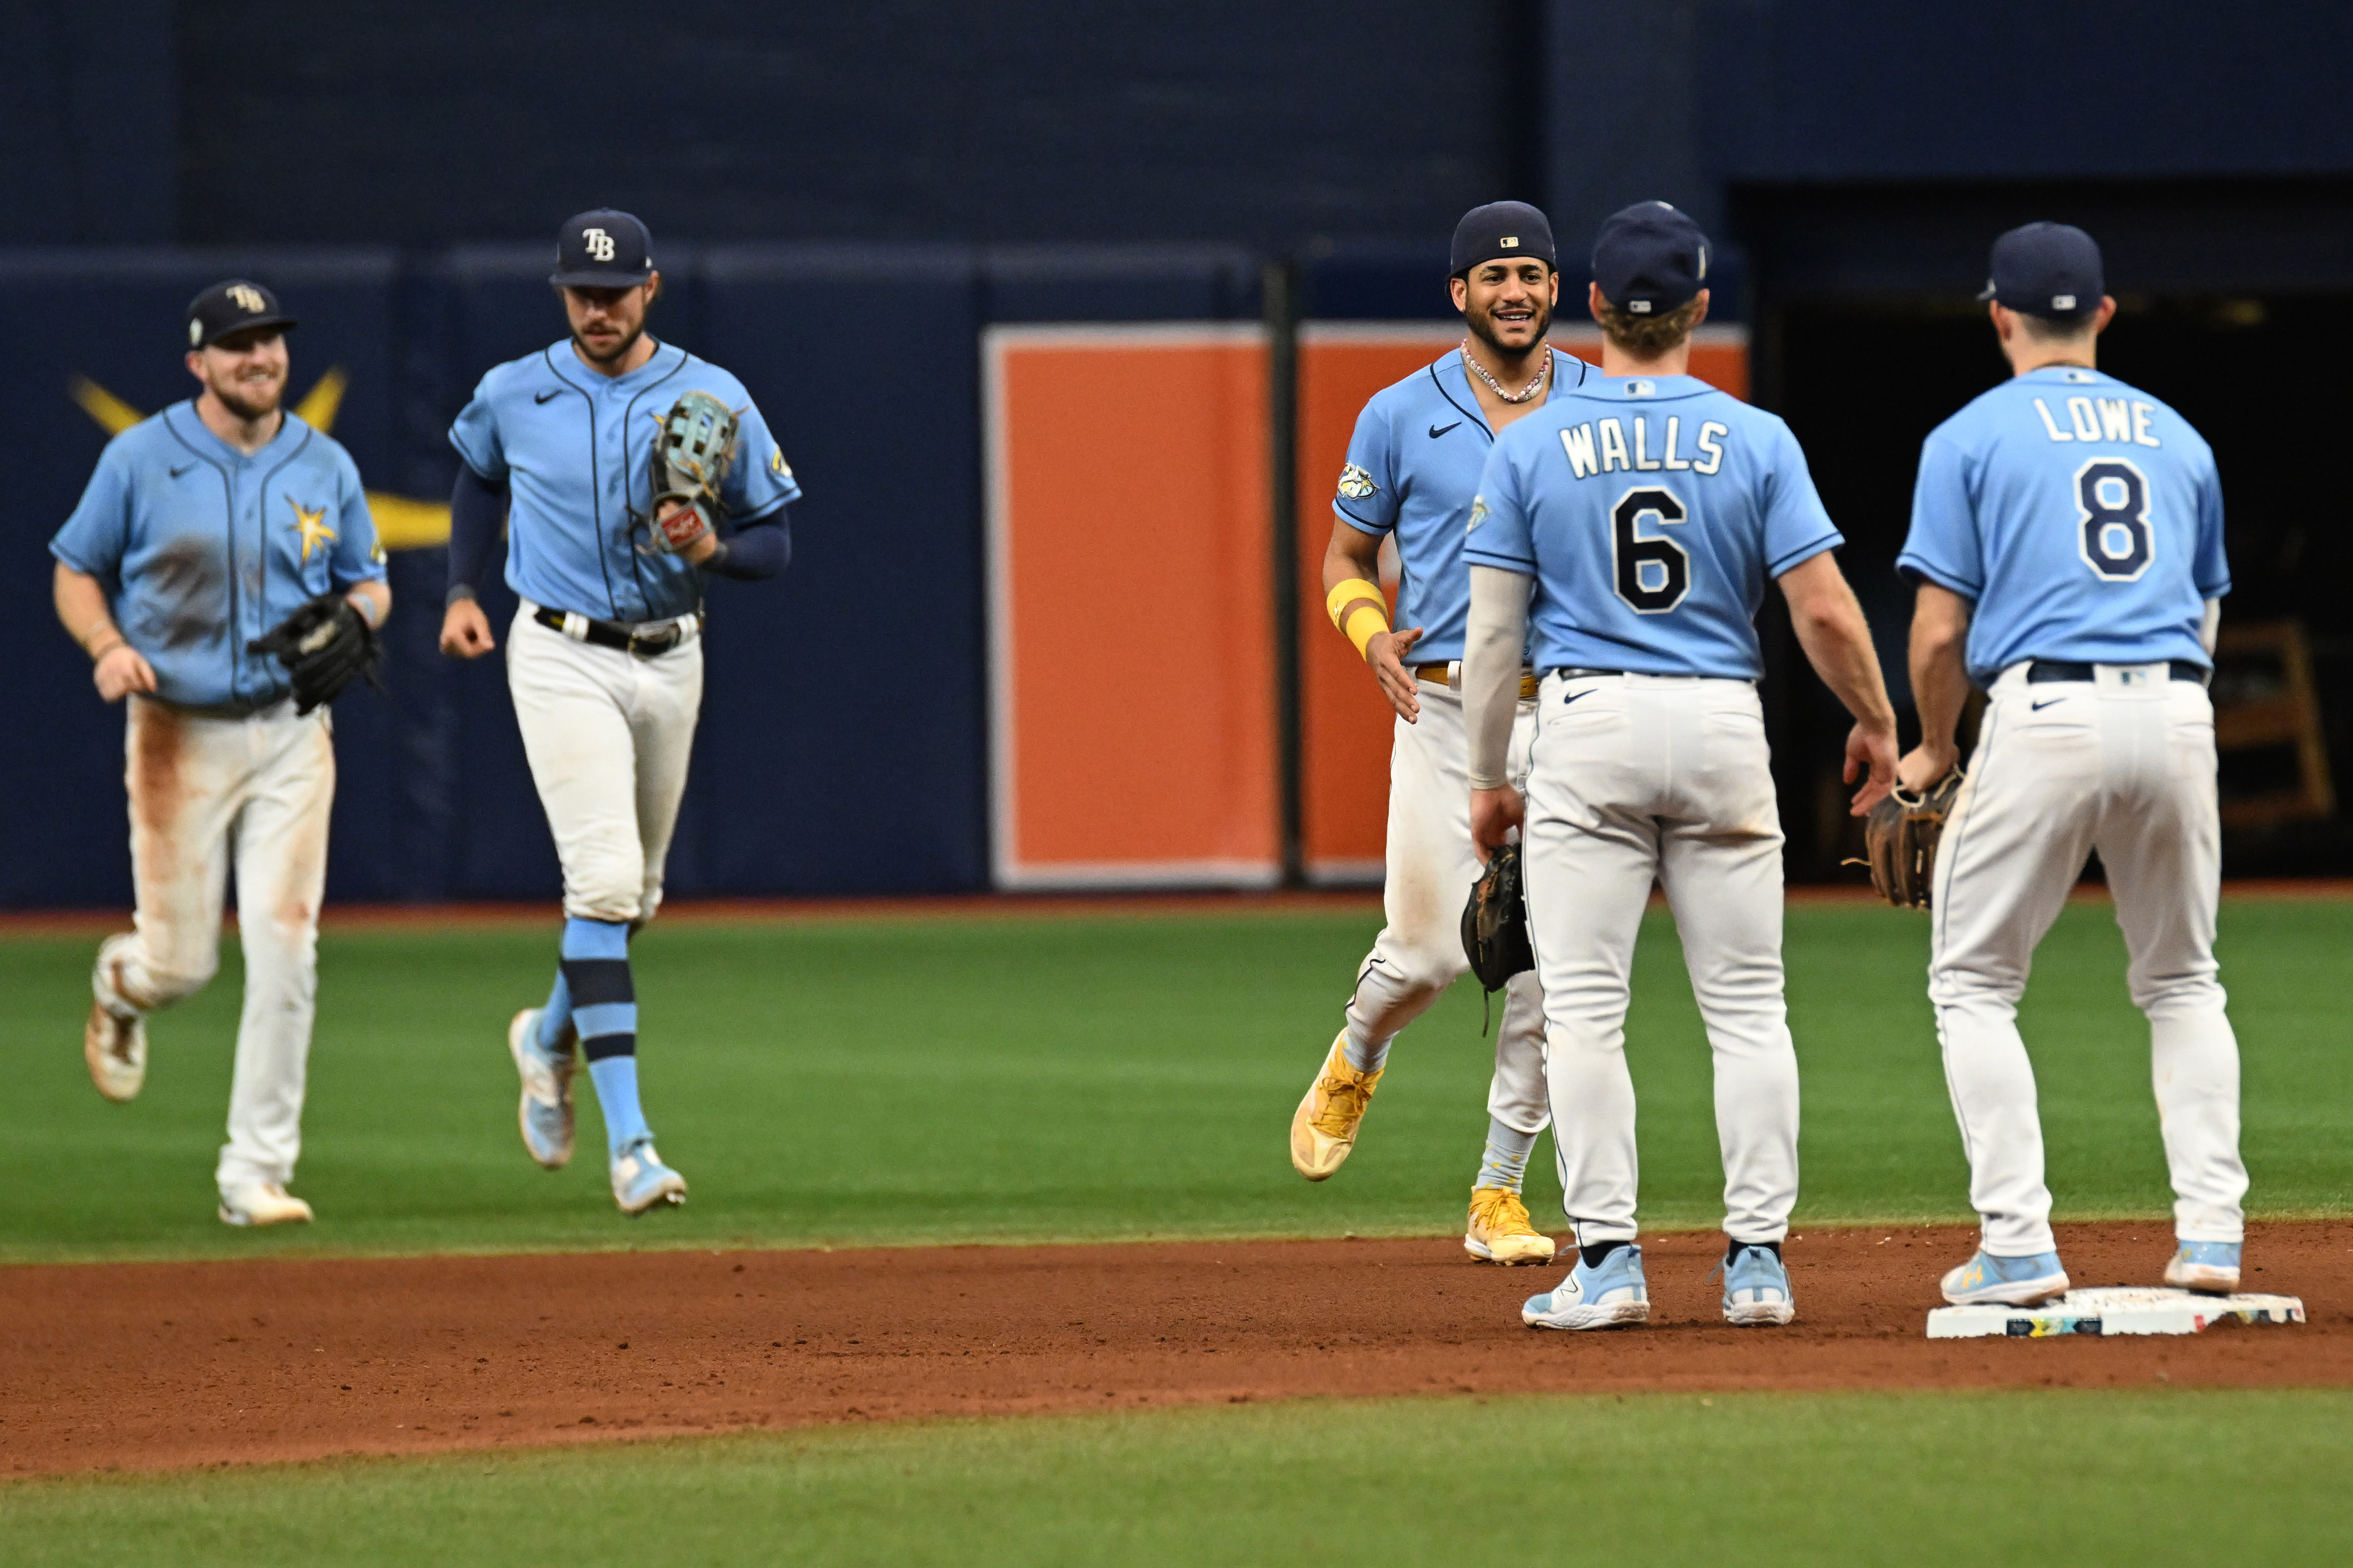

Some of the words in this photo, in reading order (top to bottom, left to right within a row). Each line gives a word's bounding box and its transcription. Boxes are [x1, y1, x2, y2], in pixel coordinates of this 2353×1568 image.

[583, 228, 615, 261] TB
[1559, 415, 1728, 479] WALLS
[2033, 396, 2162, 448] LOWE
[1611, 486, 1690, 615] 6
[2074, 457, 2155, 582] 8
